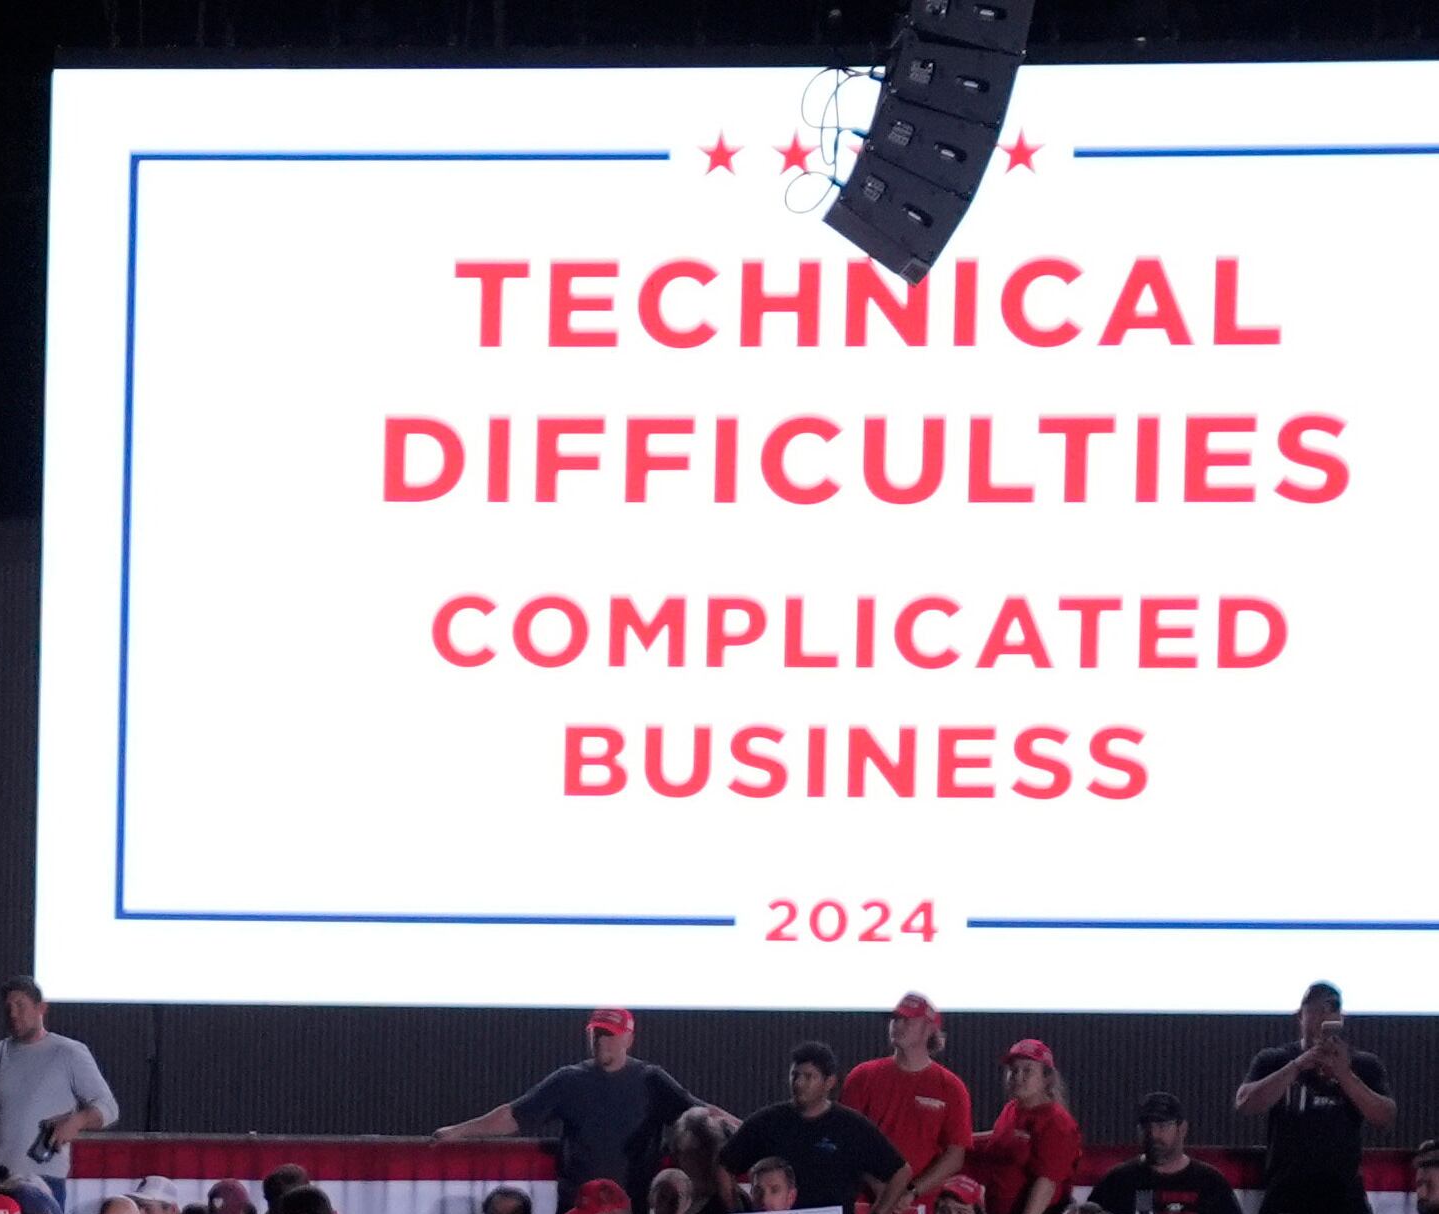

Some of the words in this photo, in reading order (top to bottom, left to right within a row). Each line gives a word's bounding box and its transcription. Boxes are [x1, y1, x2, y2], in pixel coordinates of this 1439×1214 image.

[453, 257, 1283, 349] TECHNICAL
[382, 413, 1351, 507] DIFFICULTIES
[430, 593, 1290, 671] COMPLICATED
[563, 724, 1151, 802] BUSINESS
[764, 898, 938, 944] 2024
